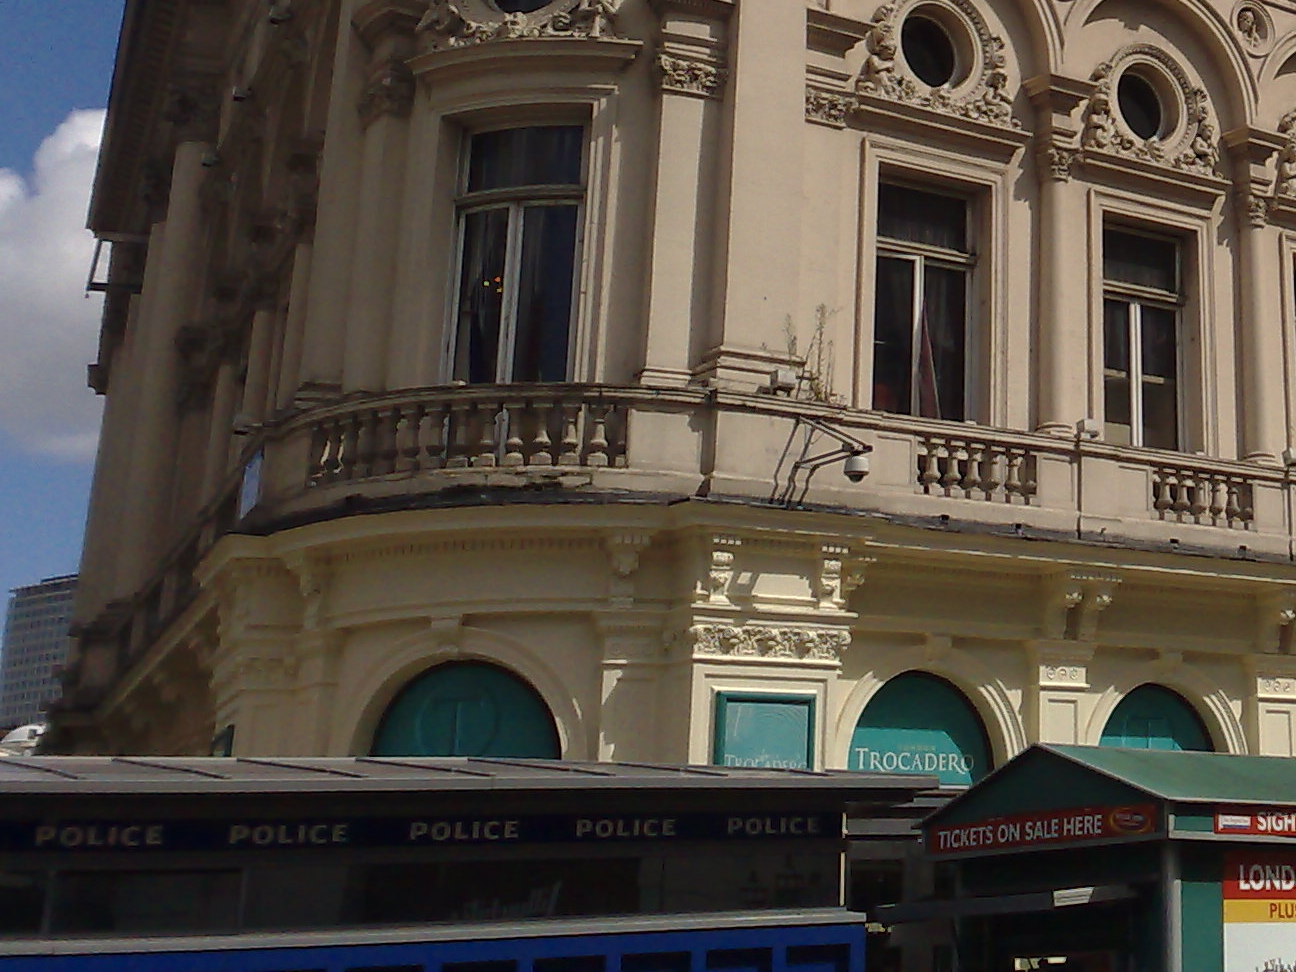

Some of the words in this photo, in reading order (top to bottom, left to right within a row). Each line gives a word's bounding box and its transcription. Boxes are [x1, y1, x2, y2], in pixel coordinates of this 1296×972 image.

[855, 747, 975, 775] TROCADERO
[34, 824, 164, 847] POLICE
[228, 823, 351, 845] POLICE
[409, 820, 520, 841] POLICE
[575, 818, 677, 837] POLICE
[726, 816, 821, 835] POLICE
[938, 825, 993, 849] TICKETS
[998, 824, 1020, 842] ON
[1025, 819, 1059, 840] SALE
[1064, 814, 1102, 837] HERE
